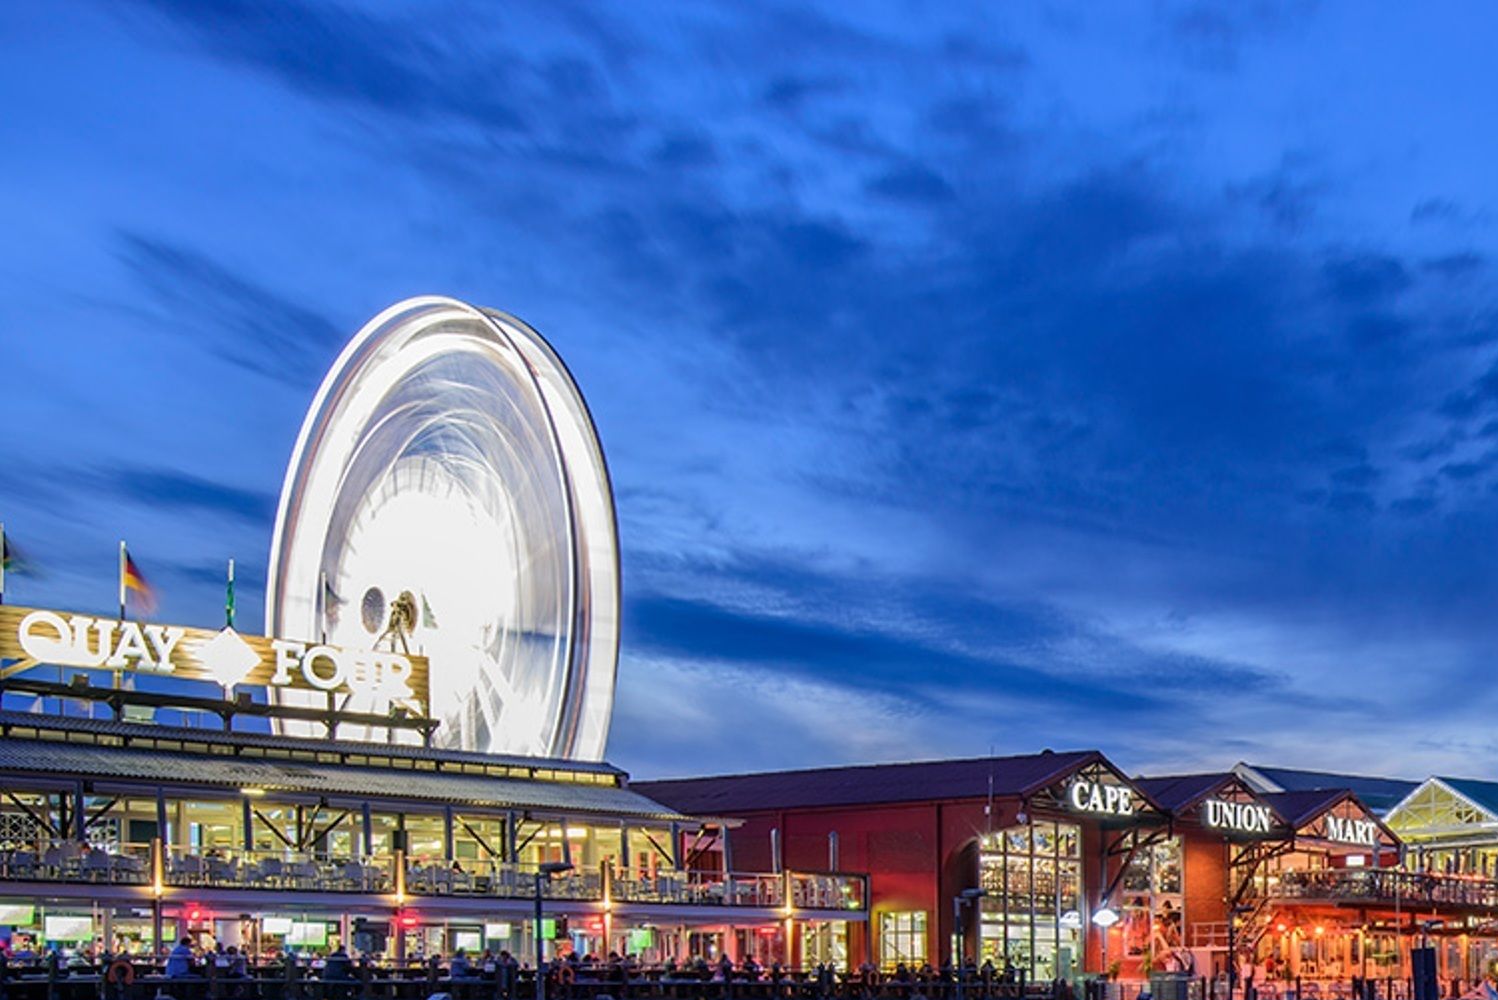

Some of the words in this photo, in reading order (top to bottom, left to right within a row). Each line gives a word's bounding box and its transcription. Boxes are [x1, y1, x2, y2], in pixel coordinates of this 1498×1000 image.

[19, 610, 186, 673] QUAY
[1072, 782, 1133, 815] CAPE
[1206, 800, 1270, 832] UNION
[1328, 816, 1376, 845] MART
